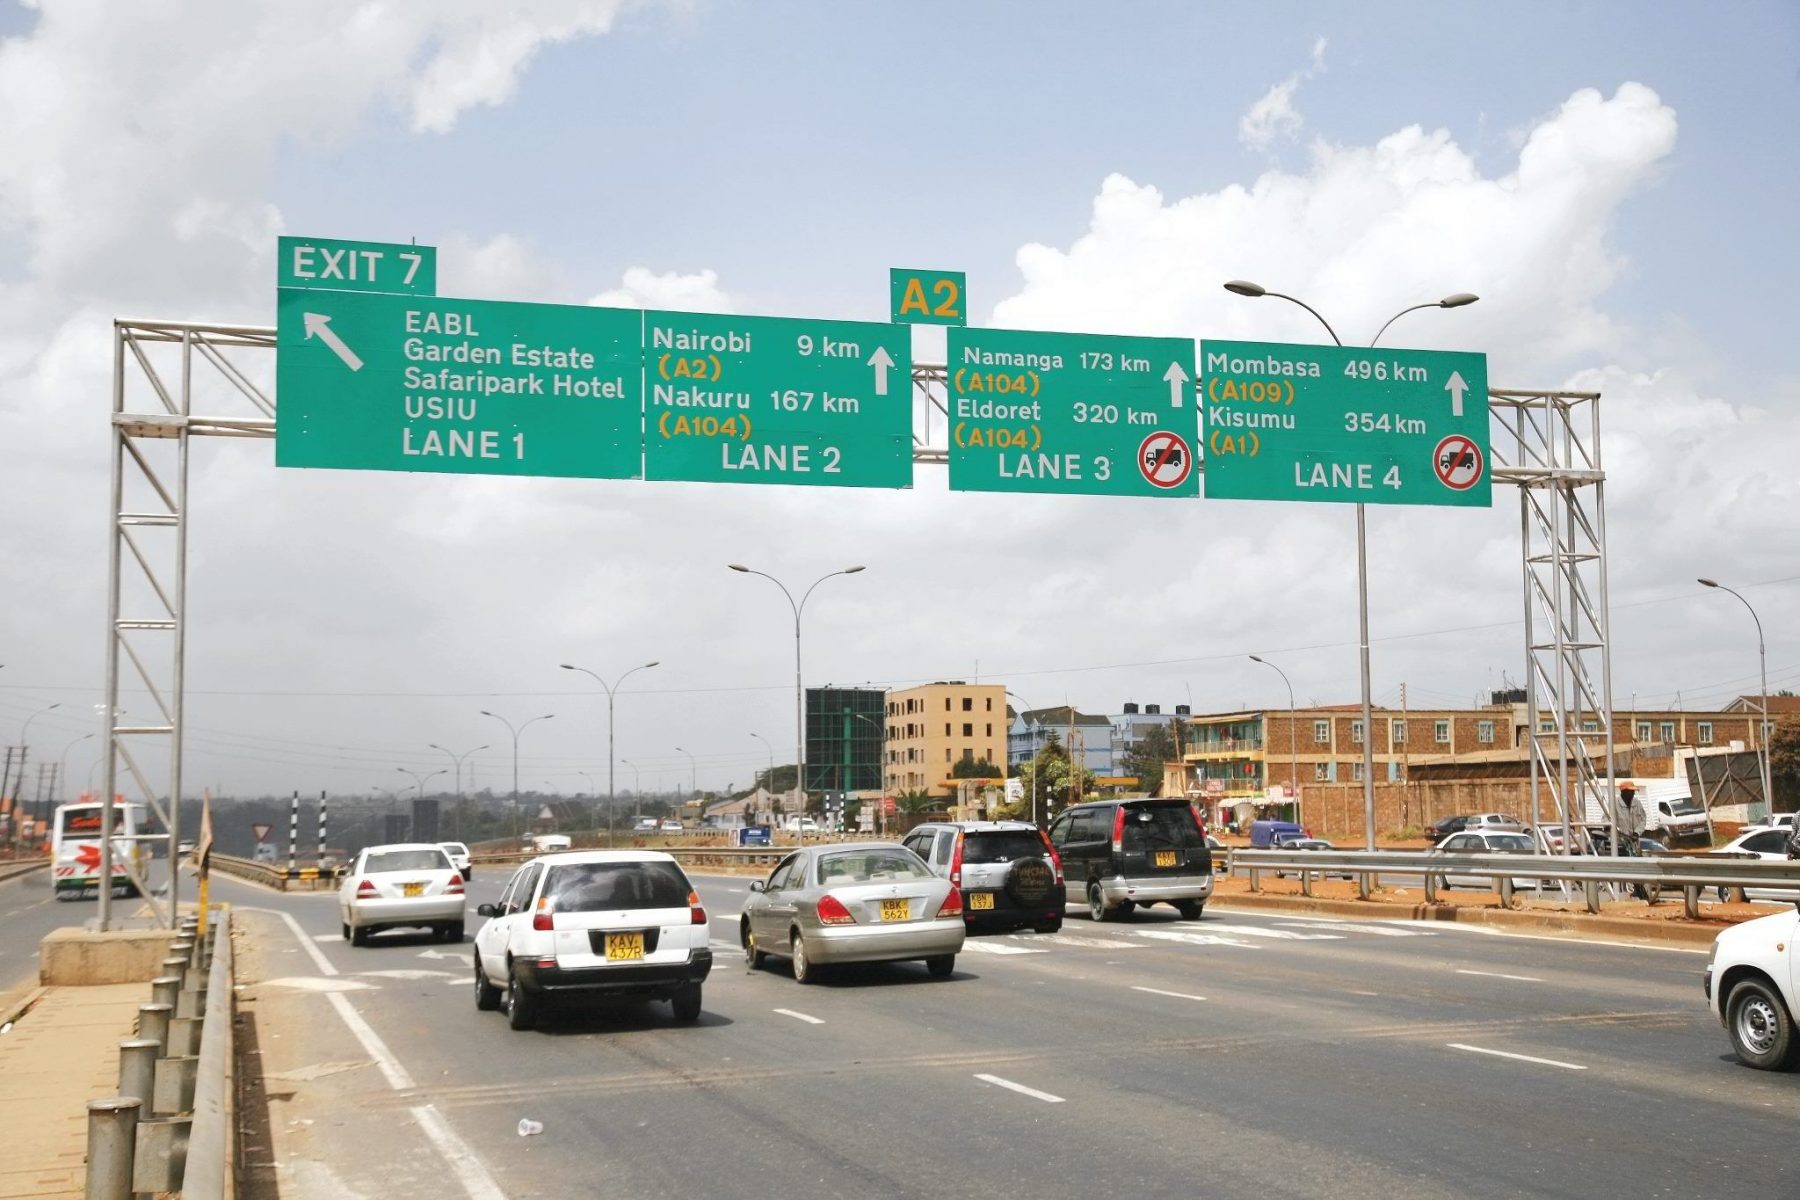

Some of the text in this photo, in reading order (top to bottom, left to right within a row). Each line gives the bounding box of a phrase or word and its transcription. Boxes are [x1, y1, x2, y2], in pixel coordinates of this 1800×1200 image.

[294, 247, 421, 284] EXIT 7
[900, 278, 958, 317] A2
[406, 311, 478, 336] EABL
[404, 338, 594, 369] Garden Estate
[654, 327, 859, 358] Nairobi 9 km
[659, 354, 721, 381] (A2)
[965, 347, 1149, 371] Namanga 173 km
[1208, 353, 1427, 381] Mombasa 496 km
[404, 367, 624, 398] Safaripark Hotel
[955, 368, 1040, 396] (A104)
[1209, 378, 1294, 405] (A109)
[405, 396, 475, 420] USIU
[654, 385, 858, 413] Nakuru 167 km
[958, 399, 1157, 424] Eldoret 320 km
[659, 412, 751, 441] (A104)
[1210, 407, 1426, 434] Kisumu 354 km
[403, 428, 523, 459] LANE 1
[955, 422, 1041, 451] (A104)
[1210, 430, 1259, 456] (A1)
[723, 443, 840, 472] LANE 2
[1000, 454, 1110, 480] LANE 3
[1296, 463, 1401, 489] LANE 4
[883, 900, 902, 910] KBK
[884, 909, 908, 920] 562Y
[609, 935, 635, 947] KAV
[610, 946, 642, 959] 437R
